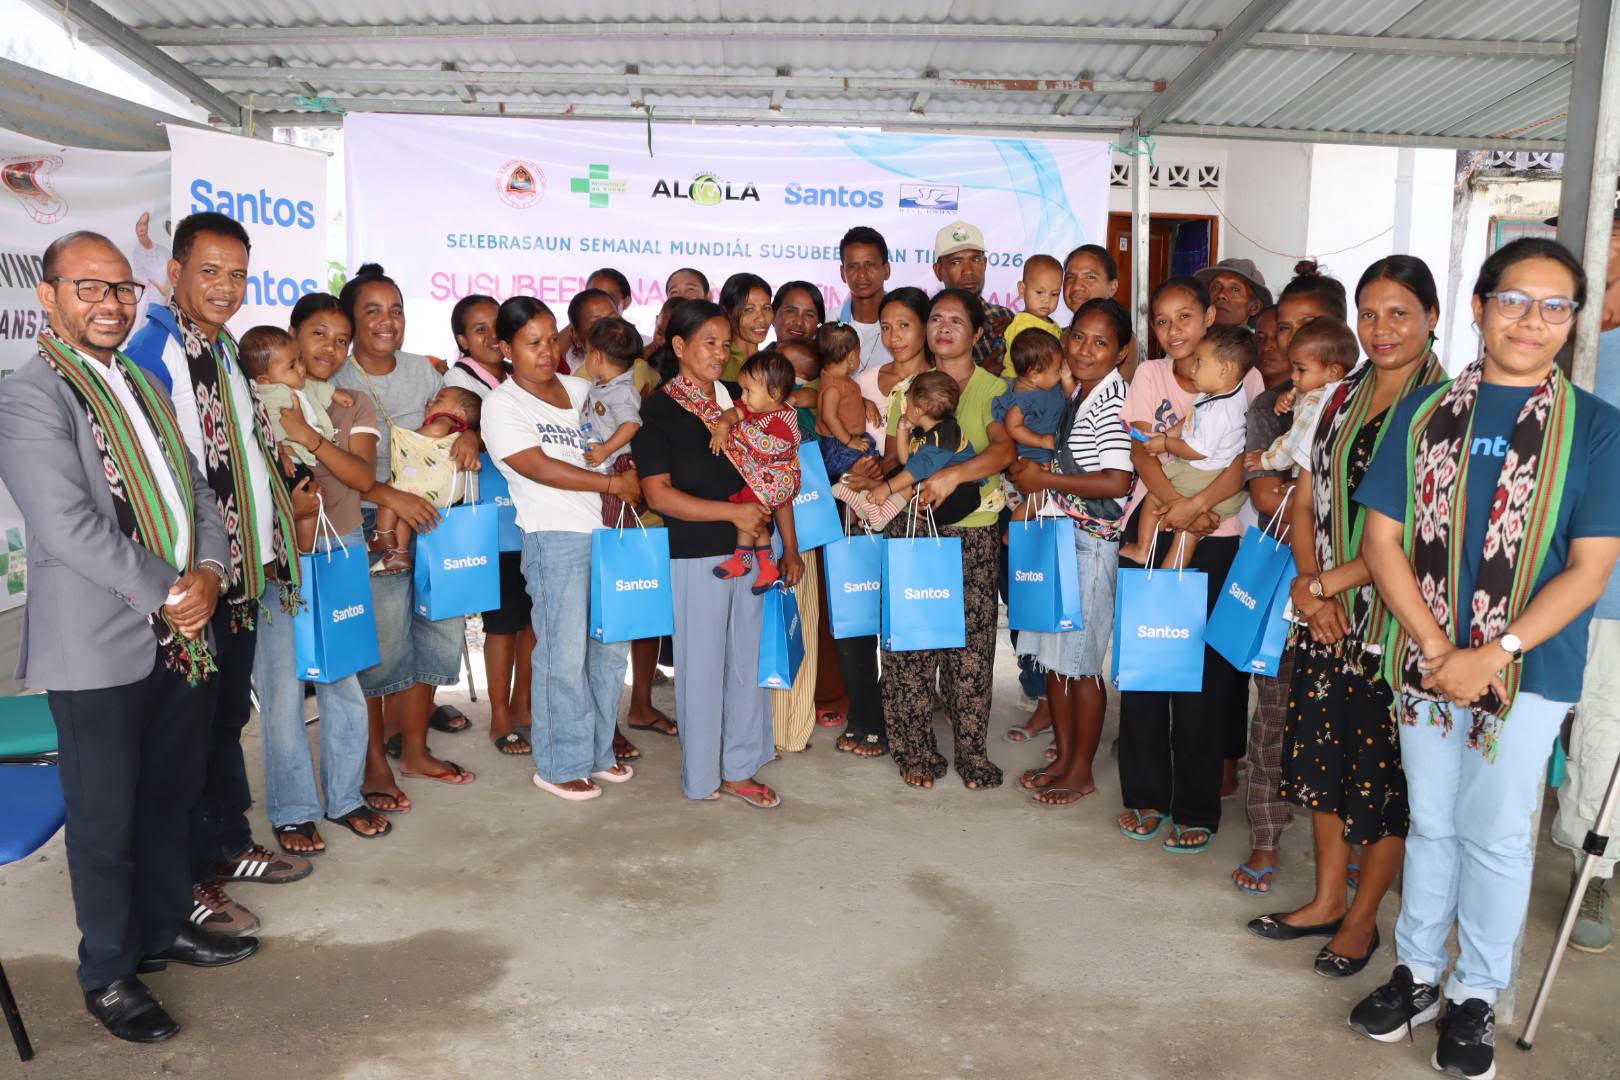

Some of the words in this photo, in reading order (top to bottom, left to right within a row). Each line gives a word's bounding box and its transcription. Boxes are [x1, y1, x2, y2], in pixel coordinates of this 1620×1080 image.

[651, 178, 760, 206] ALOLA
[784, 182, 884, 209] Santos
[190, 178, 315, 229] Santos
[446, 233, 571, 251] SELEBRASAUN
[579, 238, 662, 255] SEMANAL
[670, 239, 753, 257] MUNDIÁL
[759, 243, 842, 261] SUSUBEE
[988, 252, 1024, 268] 026
[243, 270, 318, 306] ntos
[444, 555, 488, 571] Santos
[615, 578, 659, 592] Santos
[1015, 570, 1044, 583] Santos
[844, 580, 880, 593] Santo
[904, 587, 950, 600] Santos
[1229, 582, 1257, 610] Santos
[333, 604, 365, 623] Santos
[1137, 625, 1190, 639] Santos
